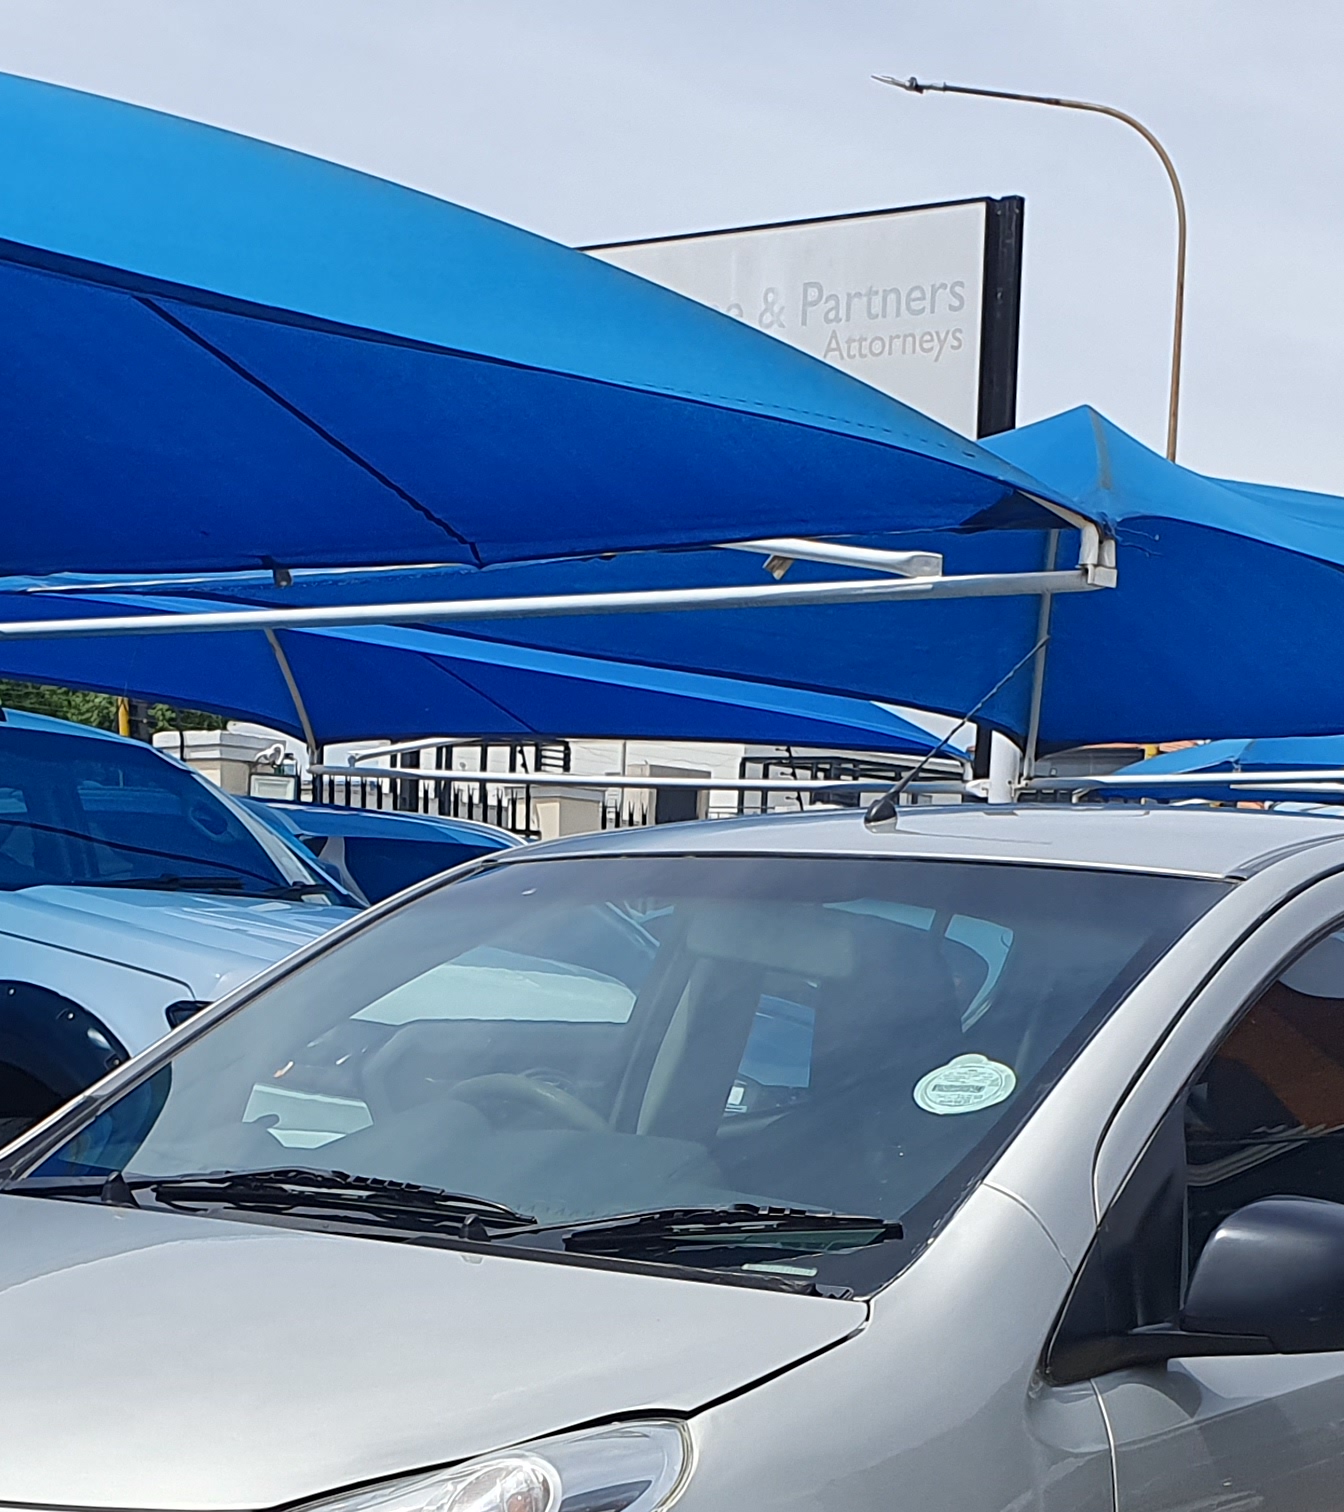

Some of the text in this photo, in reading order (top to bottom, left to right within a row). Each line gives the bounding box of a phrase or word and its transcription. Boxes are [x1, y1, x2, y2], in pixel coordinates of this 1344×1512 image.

[758, 286, 786, 329] &
[801, 280, 966, 327] Partners
[822, 327, 964, 363] Attorneys
